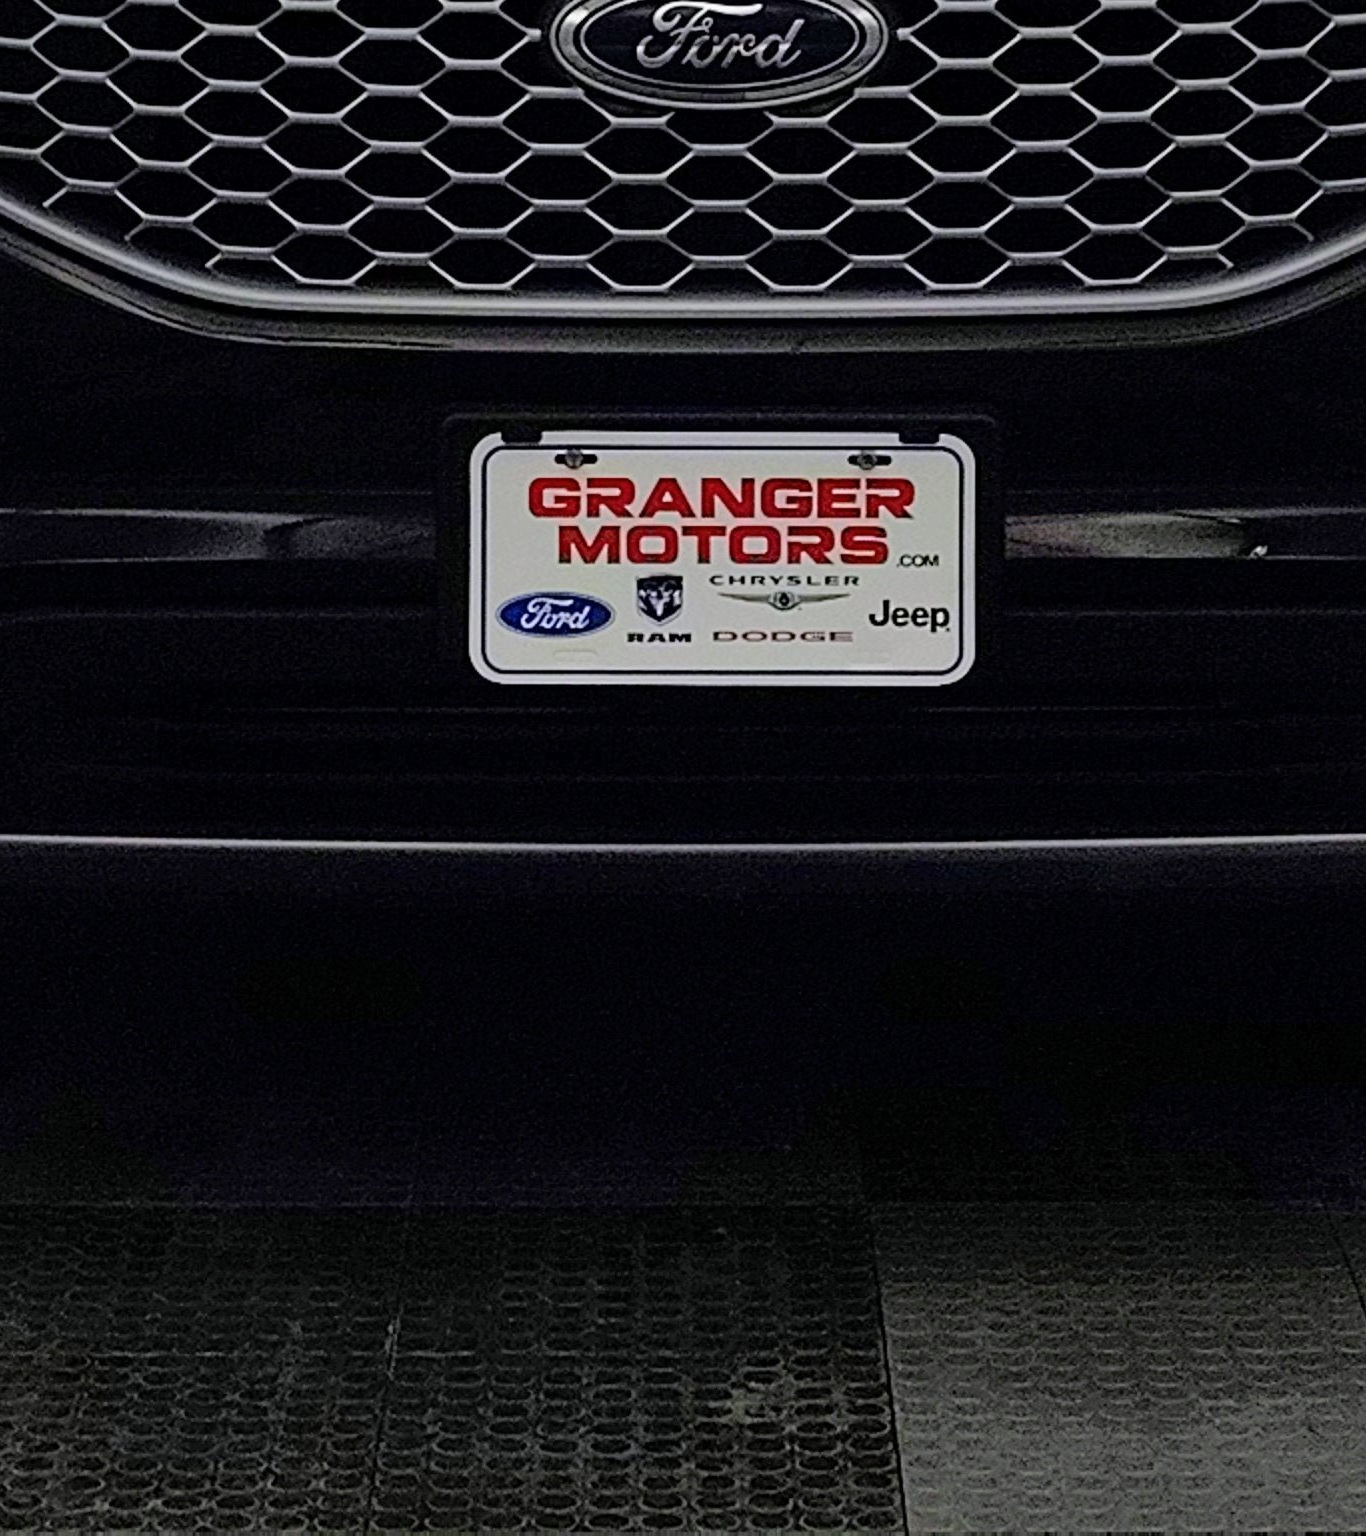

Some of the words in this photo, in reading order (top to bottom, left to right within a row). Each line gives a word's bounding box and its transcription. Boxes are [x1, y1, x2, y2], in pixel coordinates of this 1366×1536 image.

[636, 0, 805, 68] Ford
[528, 478, 915, 519] GRANGER
[558, 525, 889, 565] MOTORS
[709, 575, 860, 586] CHRYSLER
[520, 597, 590, 629] Ford
[869, 600, 950, 633] Jeep
[627, 633, 692, 643] RAM
[713, 631, 853, 642] DODGE
